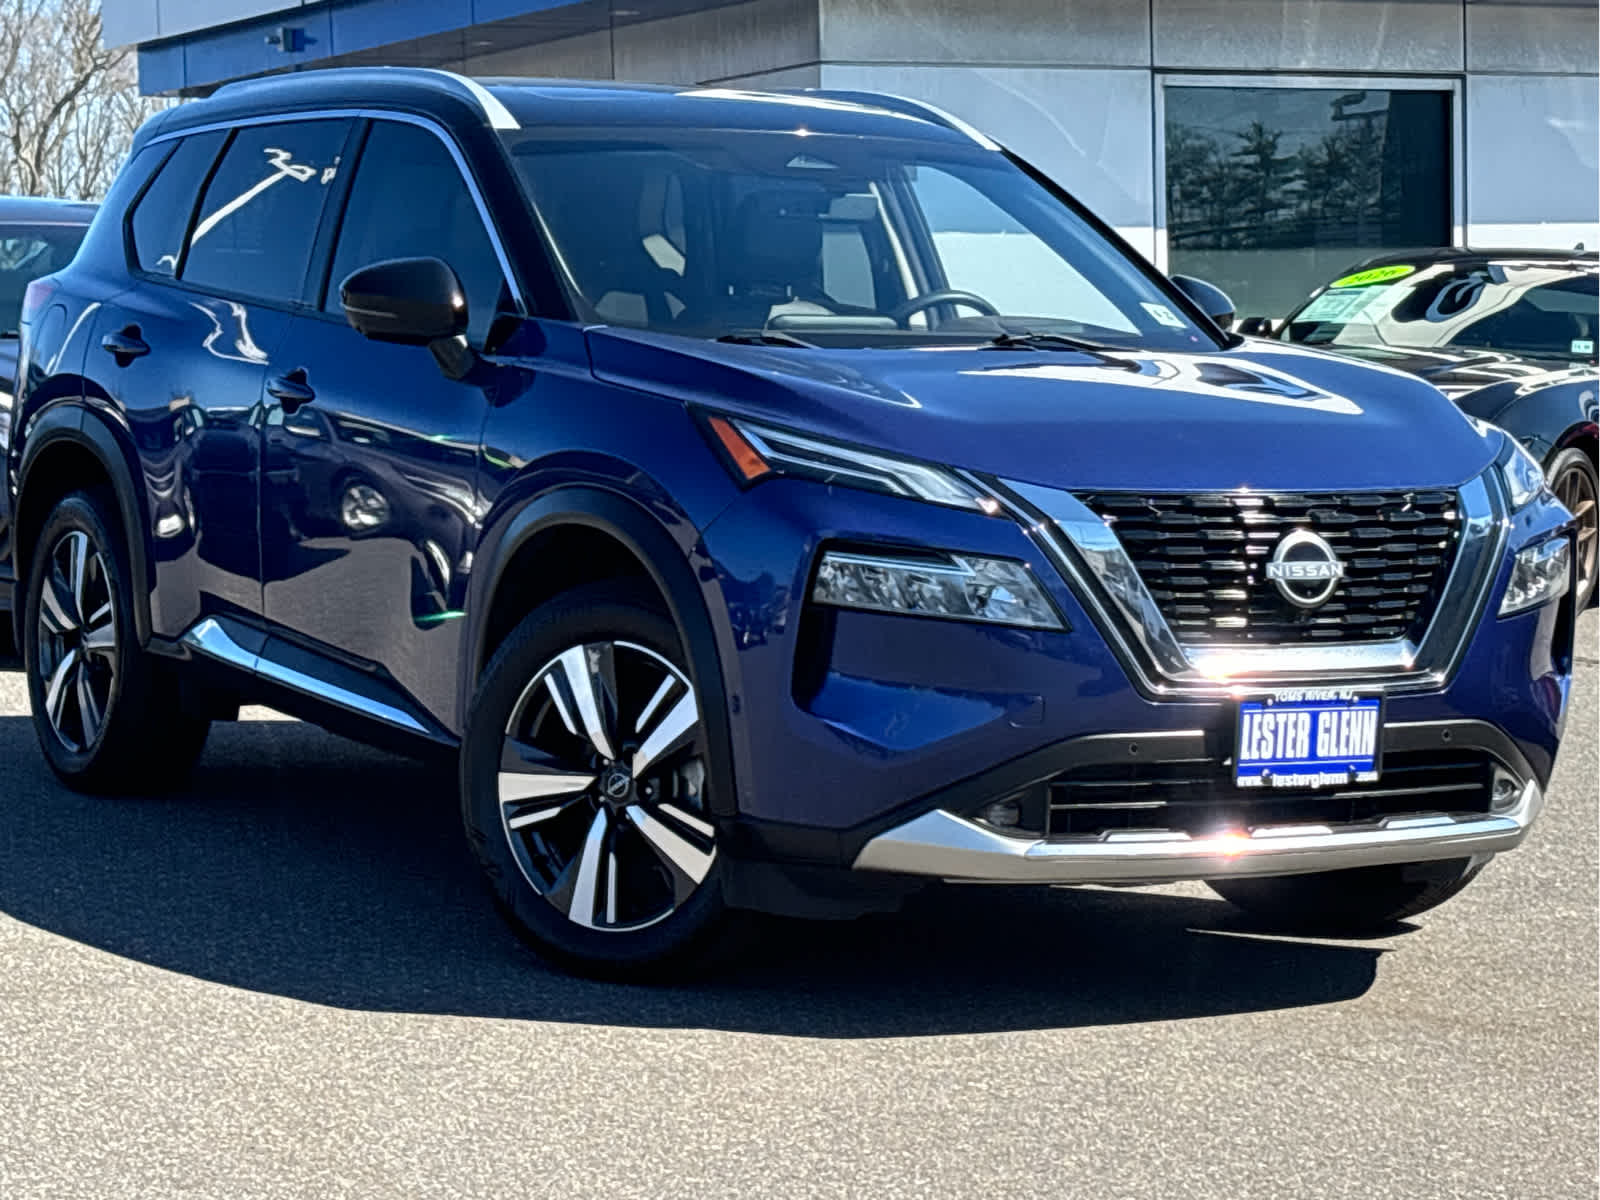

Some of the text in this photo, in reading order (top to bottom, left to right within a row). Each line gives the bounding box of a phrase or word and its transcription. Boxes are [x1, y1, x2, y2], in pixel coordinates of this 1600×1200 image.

[1269, 564, 1343, 577] NISSAN
[1240, 710, 1377, 760] LESTER GLENN
[1272, 772, 1348, 789] lesterglenn
